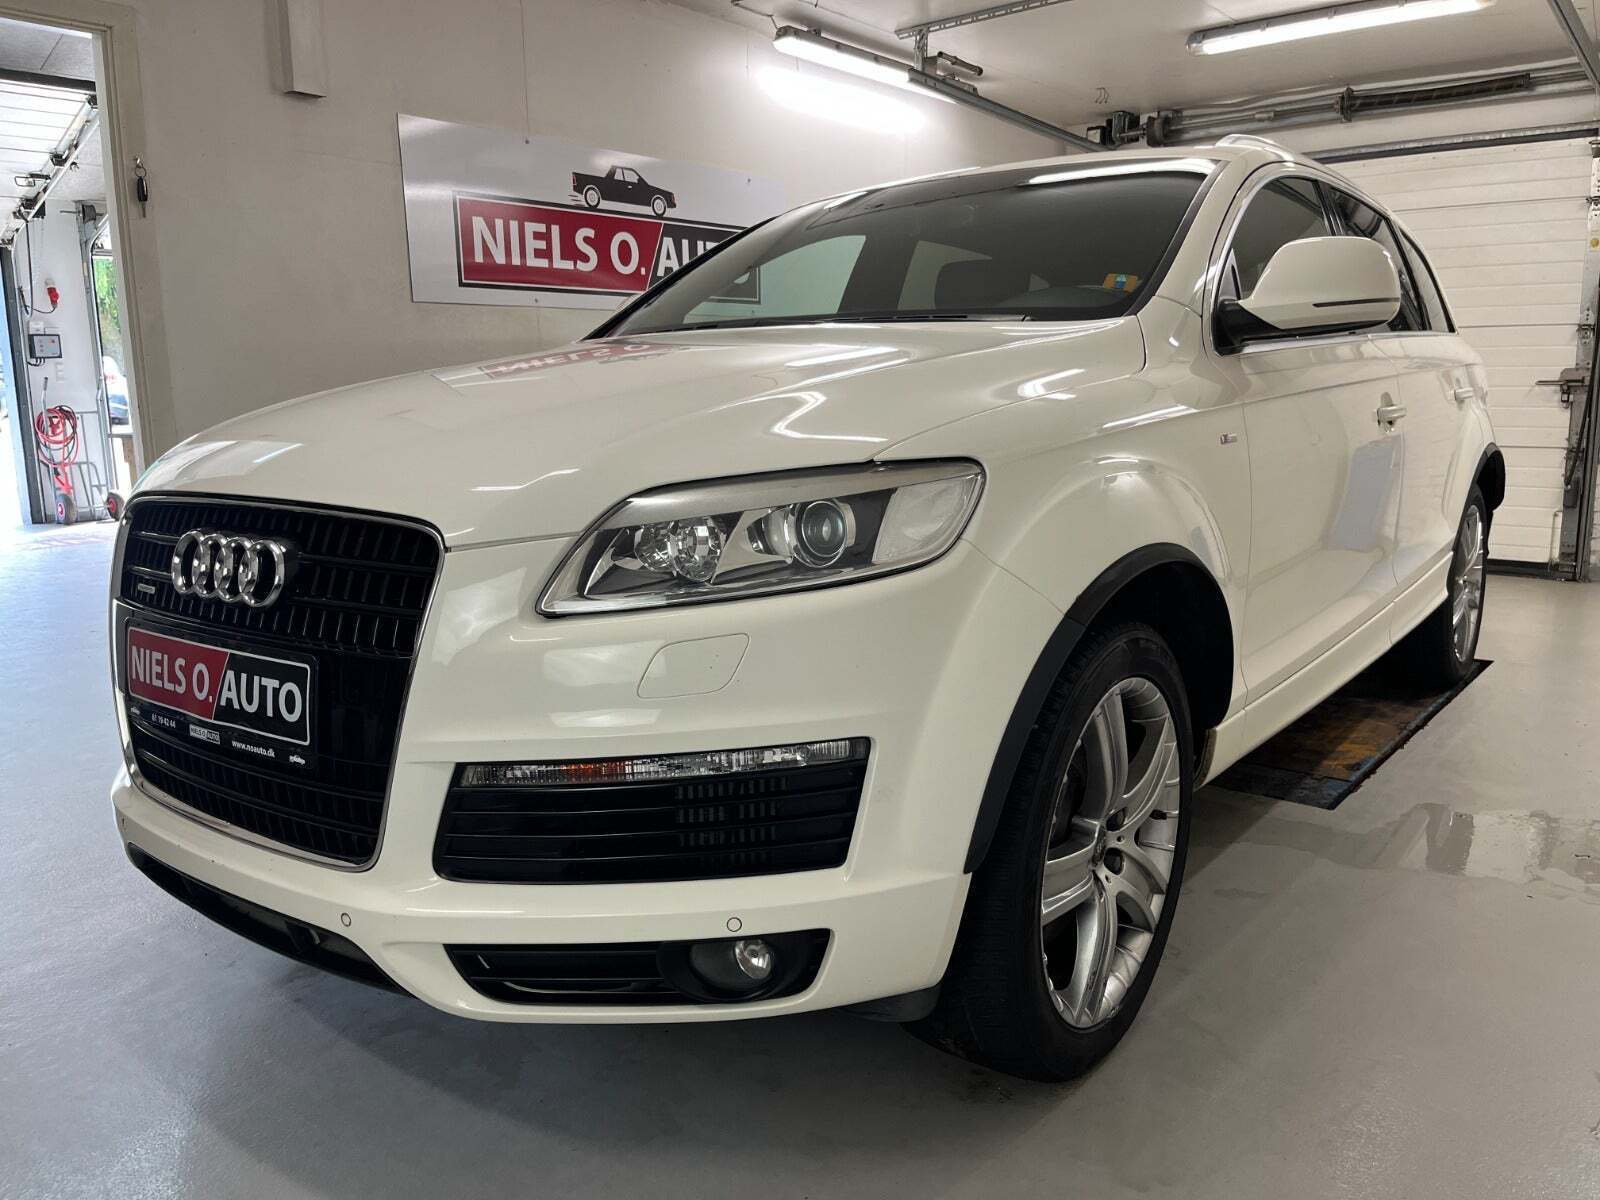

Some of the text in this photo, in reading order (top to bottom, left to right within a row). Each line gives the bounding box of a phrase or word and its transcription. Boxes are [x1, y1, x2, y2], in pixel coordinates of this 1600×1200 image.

[472, 215, 598, 272] NIELS
[610, 231, 646, 276] O.
[132, 645, 302, 723] NIELS O. AUTO
